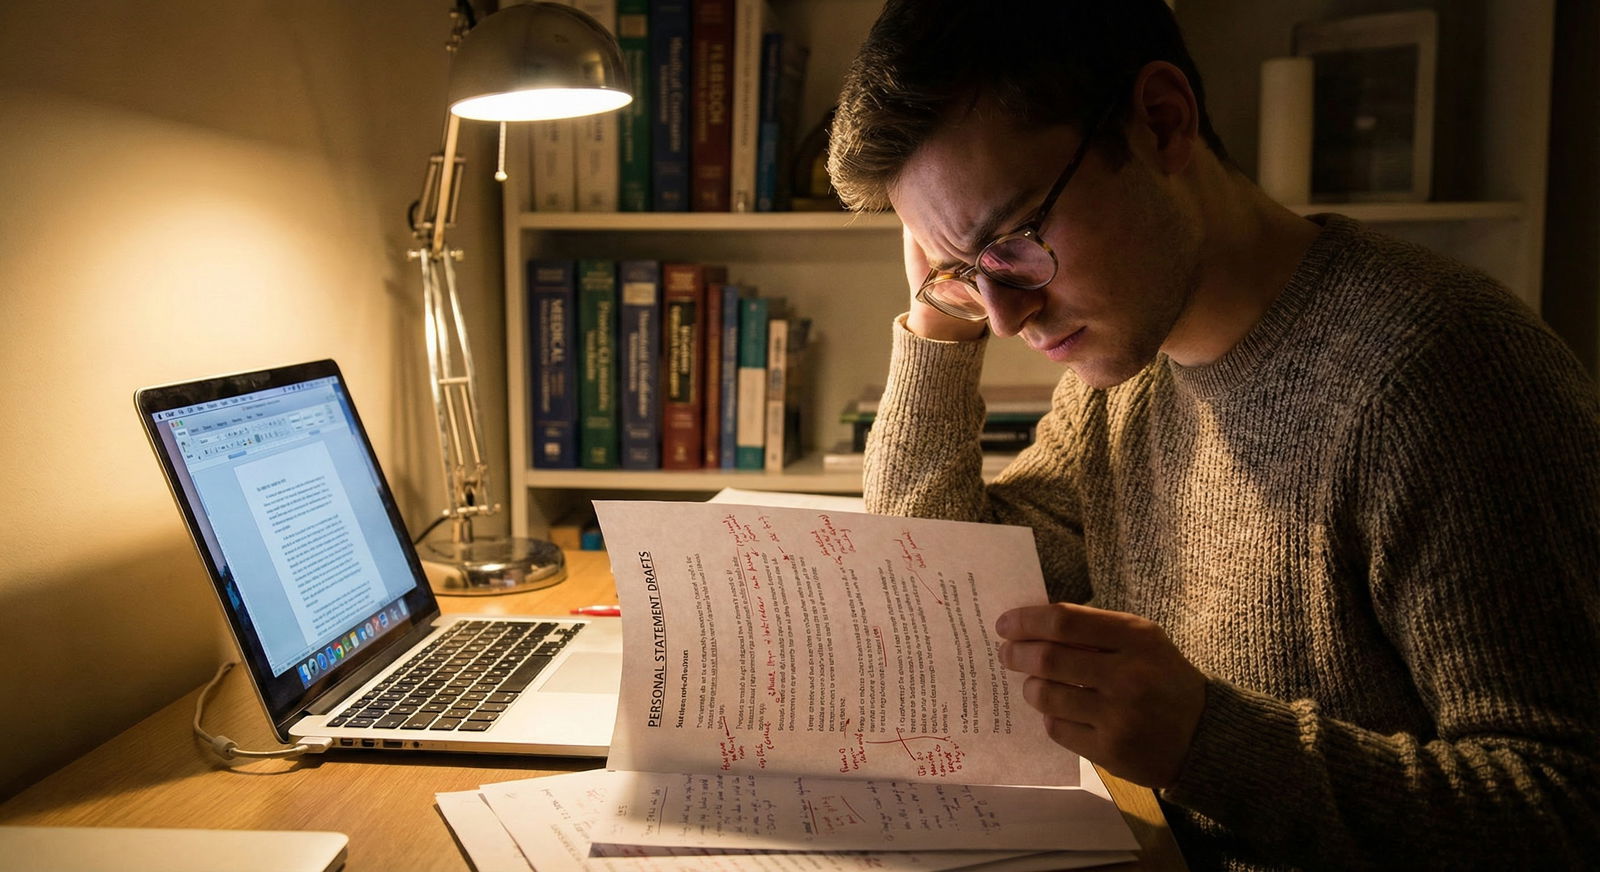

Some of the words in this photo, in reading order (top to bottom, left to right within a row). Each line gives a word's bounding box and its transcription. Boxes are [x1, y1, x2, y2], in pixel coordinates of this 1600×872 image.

[551, 299, 564, 362] MEDICAL
[638, 551, 658, 592] DRAFTS
[649, 595, 665, 662] STATEMENT
[648, 666, 665, 728] PERSONAL
